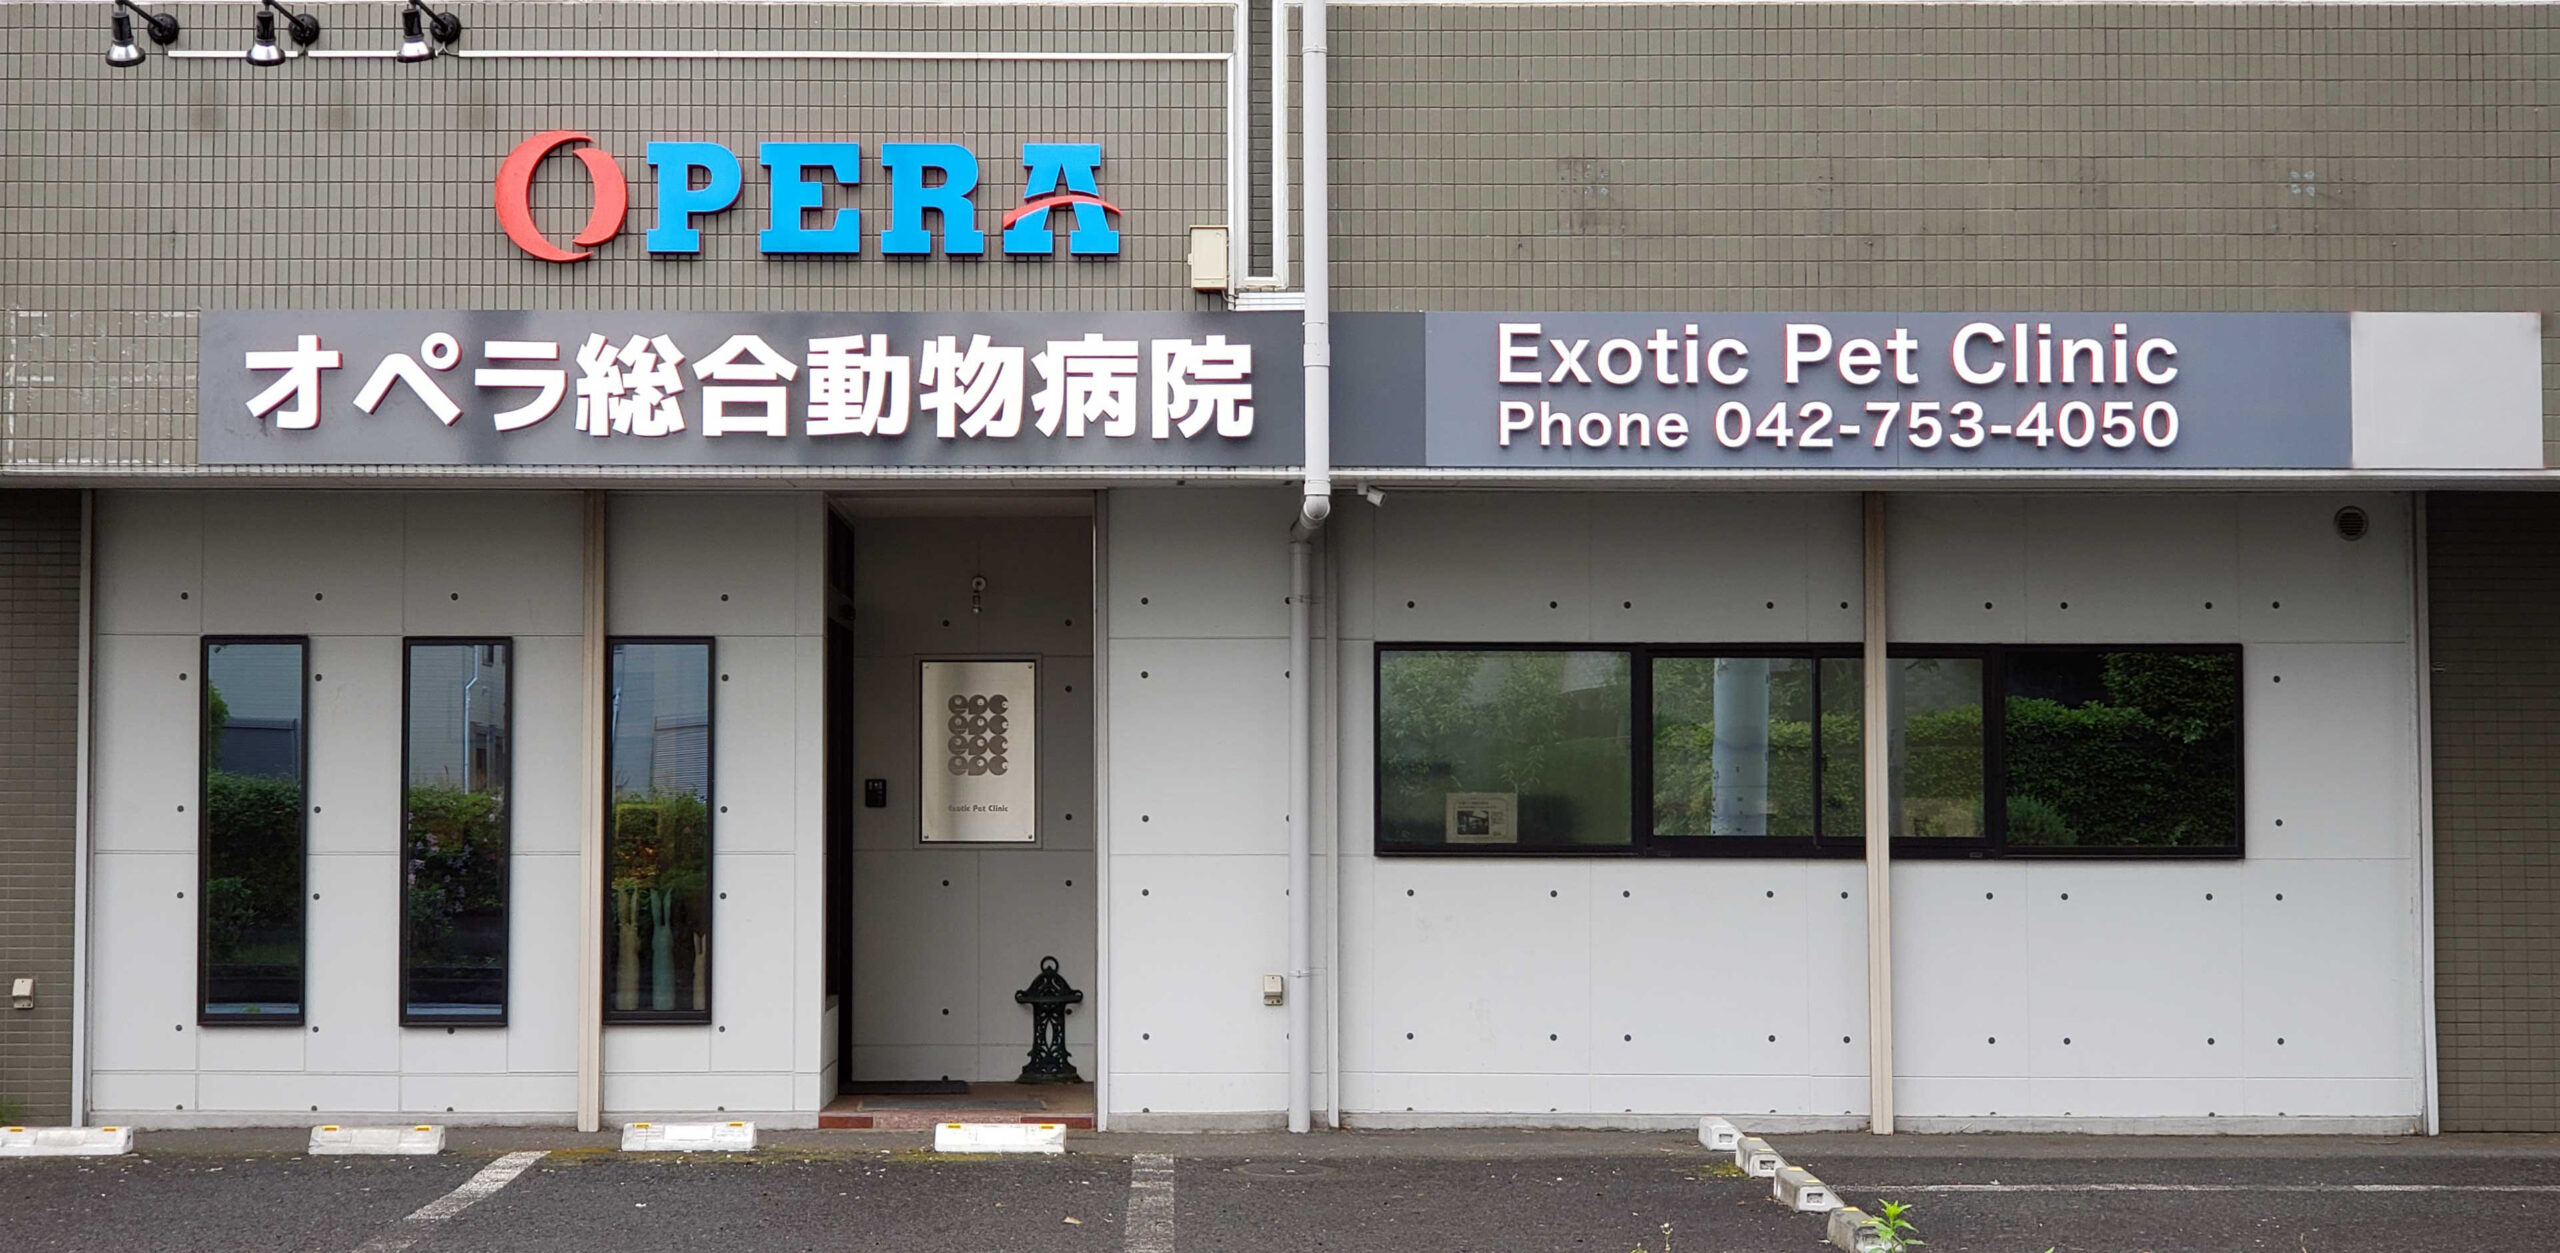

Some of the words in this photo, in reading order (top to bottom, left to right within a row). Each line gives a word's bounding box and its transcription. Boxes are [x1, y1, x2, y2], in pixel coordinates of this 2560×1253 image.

[495, 130, 1123, 262] OPERA
[1498, 322, 1749, 385] Exotic
[1784, 323, 1919, 385] Pet
[1951, 322, 2178, 385] Clinic
[244, 332, 1255, 440] オペラ総合動物病院
[1499, 400, 1689, 448] Phone
[1714, 400, 2179, 448] 042-753-4050
[973, 804, 986, 812] Pet
[988, 804, 1008, 812] Clinic
